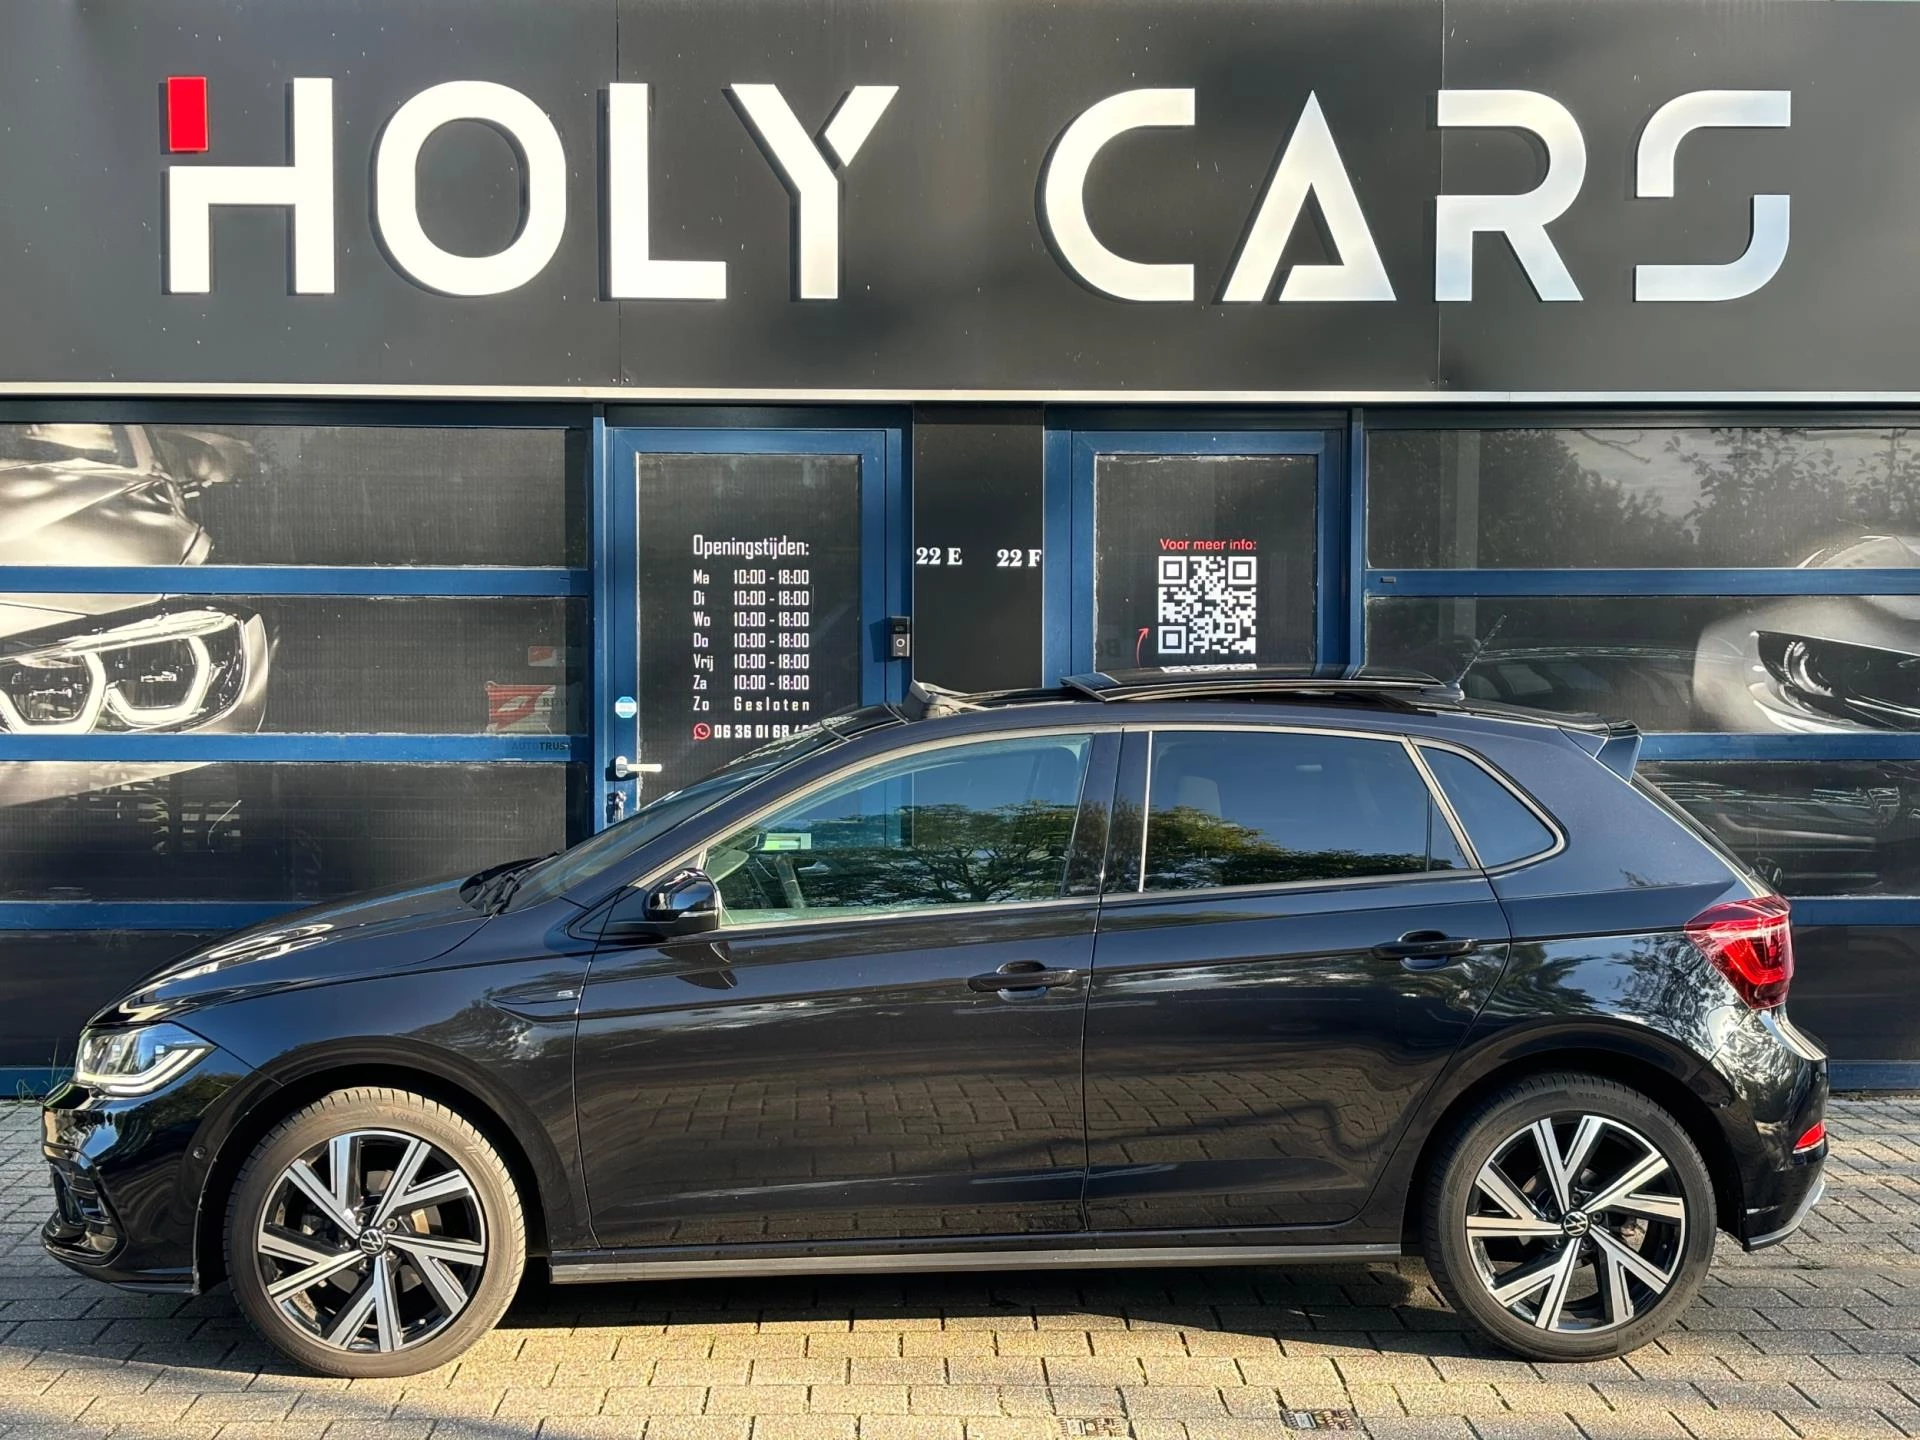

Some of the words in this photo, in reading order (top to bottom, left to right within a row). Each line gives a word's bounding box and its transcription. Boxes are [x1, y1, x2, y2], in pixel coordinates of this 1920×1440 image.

[167, 75, 899, 299] HOLY
[1045, 87, 1791, 302] CARS
[693, 534, 810, 559] Openingstijden:
[1160, 538, 1191, 550] Voor
[1194, 541, 1227, 550] meer
[1230, 539, 1257, 550] info:
[915, 547, 942, 565] 22
[947, 547, 963, 566] E
[996, 549, 1023, 567] 22
[1028, 549, 1042, 567] F
[693, 569, 710, 585] Ma
[733, 570, 766, 585] 10:00
[778, 570, 810, 585] 18:00
[693, 590, 705, 606] Di
[733, 591, 766, 606] 10:00
[778, 591, 810, 606] 18:00
[693, 611, 711, 627] Wo
[733, 612, 766, 627] 10:00
[778, 612, 810, 627] 18:00
[693, 632, 709, 648] Do
[733, 633, 766, 648] 10:00
[778, 633, 810, 648] 18:00
[693, 654, 714, 672] Vrij
[733, 654, 766, 669] 10:00
[778, 654, 810, 669] 18:00
[693, 675, 708, 690] Za
[733, 675, 766, 690] 10:00
[778, 675, 810, 690] 18:00
[693, 696, 710, 711] Zo
[733, 696, 810, 711] Gesloten
[714, 724, 731, 739] 06
[735, 724, 752, 739] 36
[755, 724, 769, 739] 01
[773, 724, 790, 739] 68
